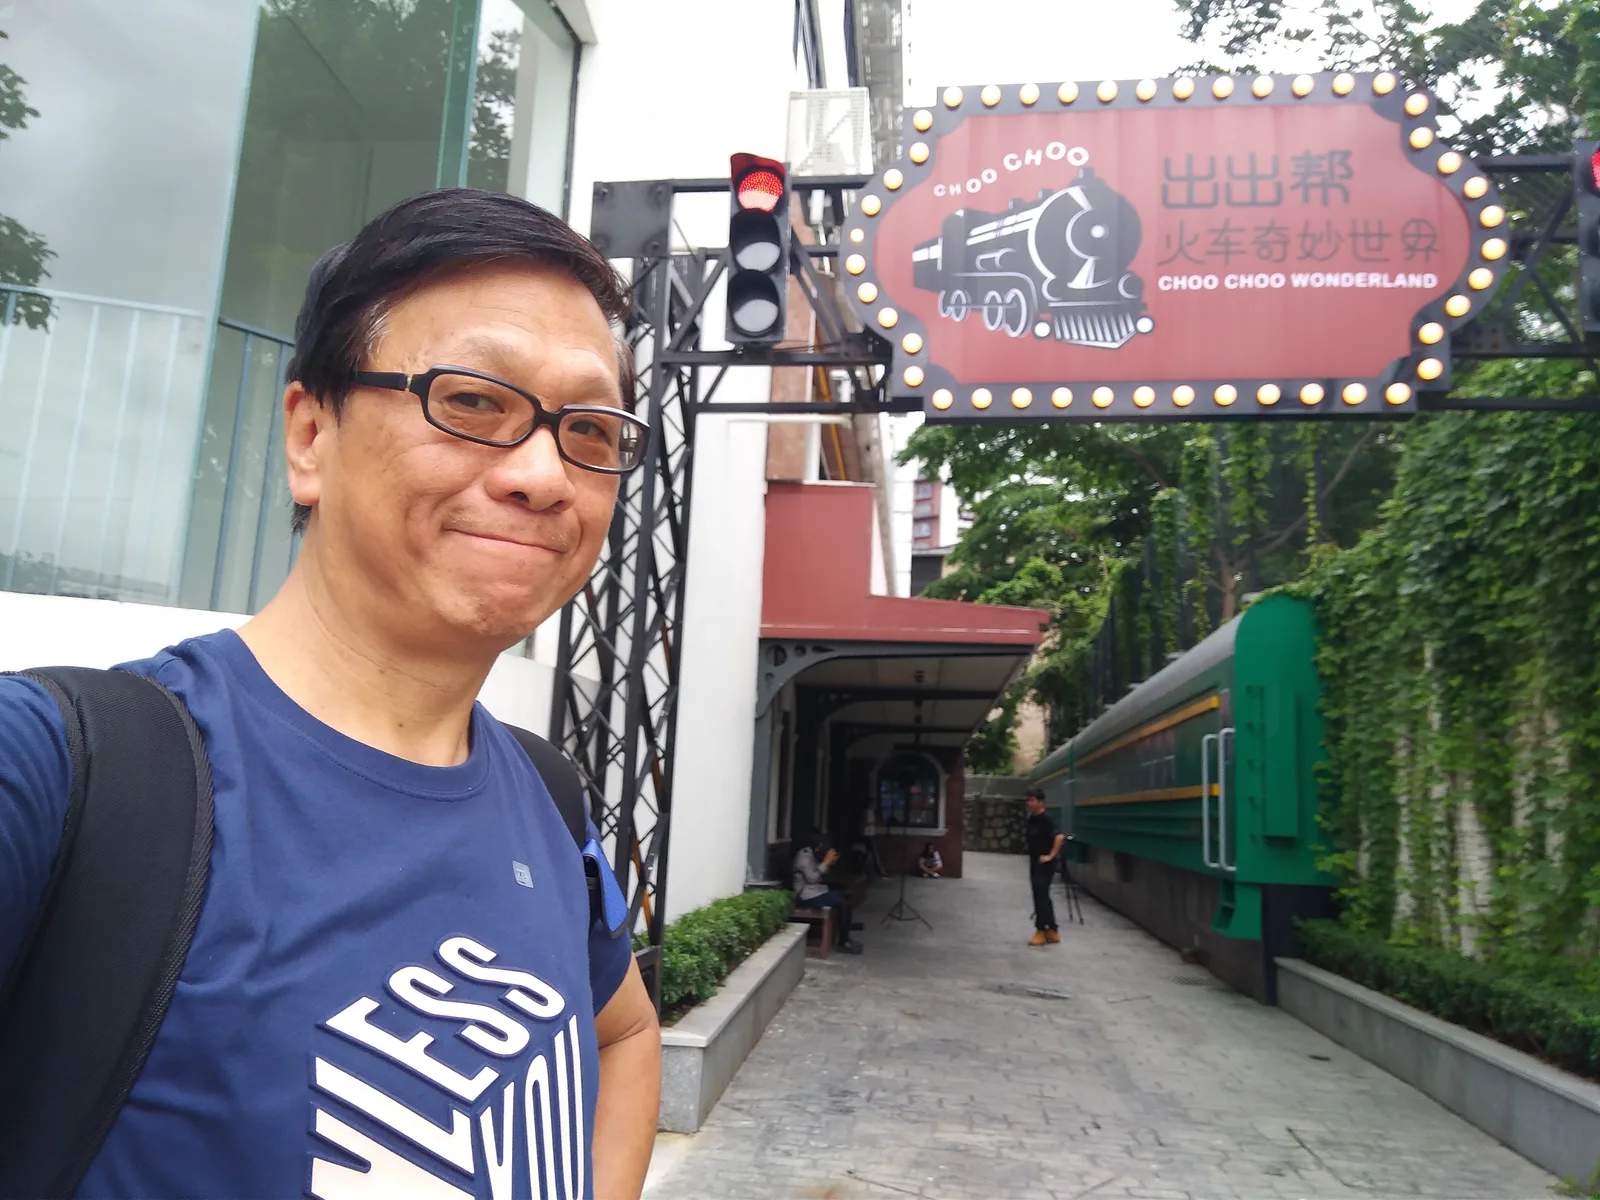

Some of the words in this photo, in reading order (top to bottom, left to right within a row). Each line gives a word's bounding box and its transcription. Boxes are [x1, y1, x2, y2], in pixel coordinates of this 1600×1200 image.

[933, 168, 998, 197] CHOO
[1003, 141, 1090, 171] CHOO
[1161, 150, 1353, 209] 出出帮
[1157, 218, 1440, 266] 火车奇妙世界
[1158, 274, 1220, 291] CHOO
[1224, 272, 1286, 290] CHOO
[1290, 271, 1439, 289] WONDERLAND
